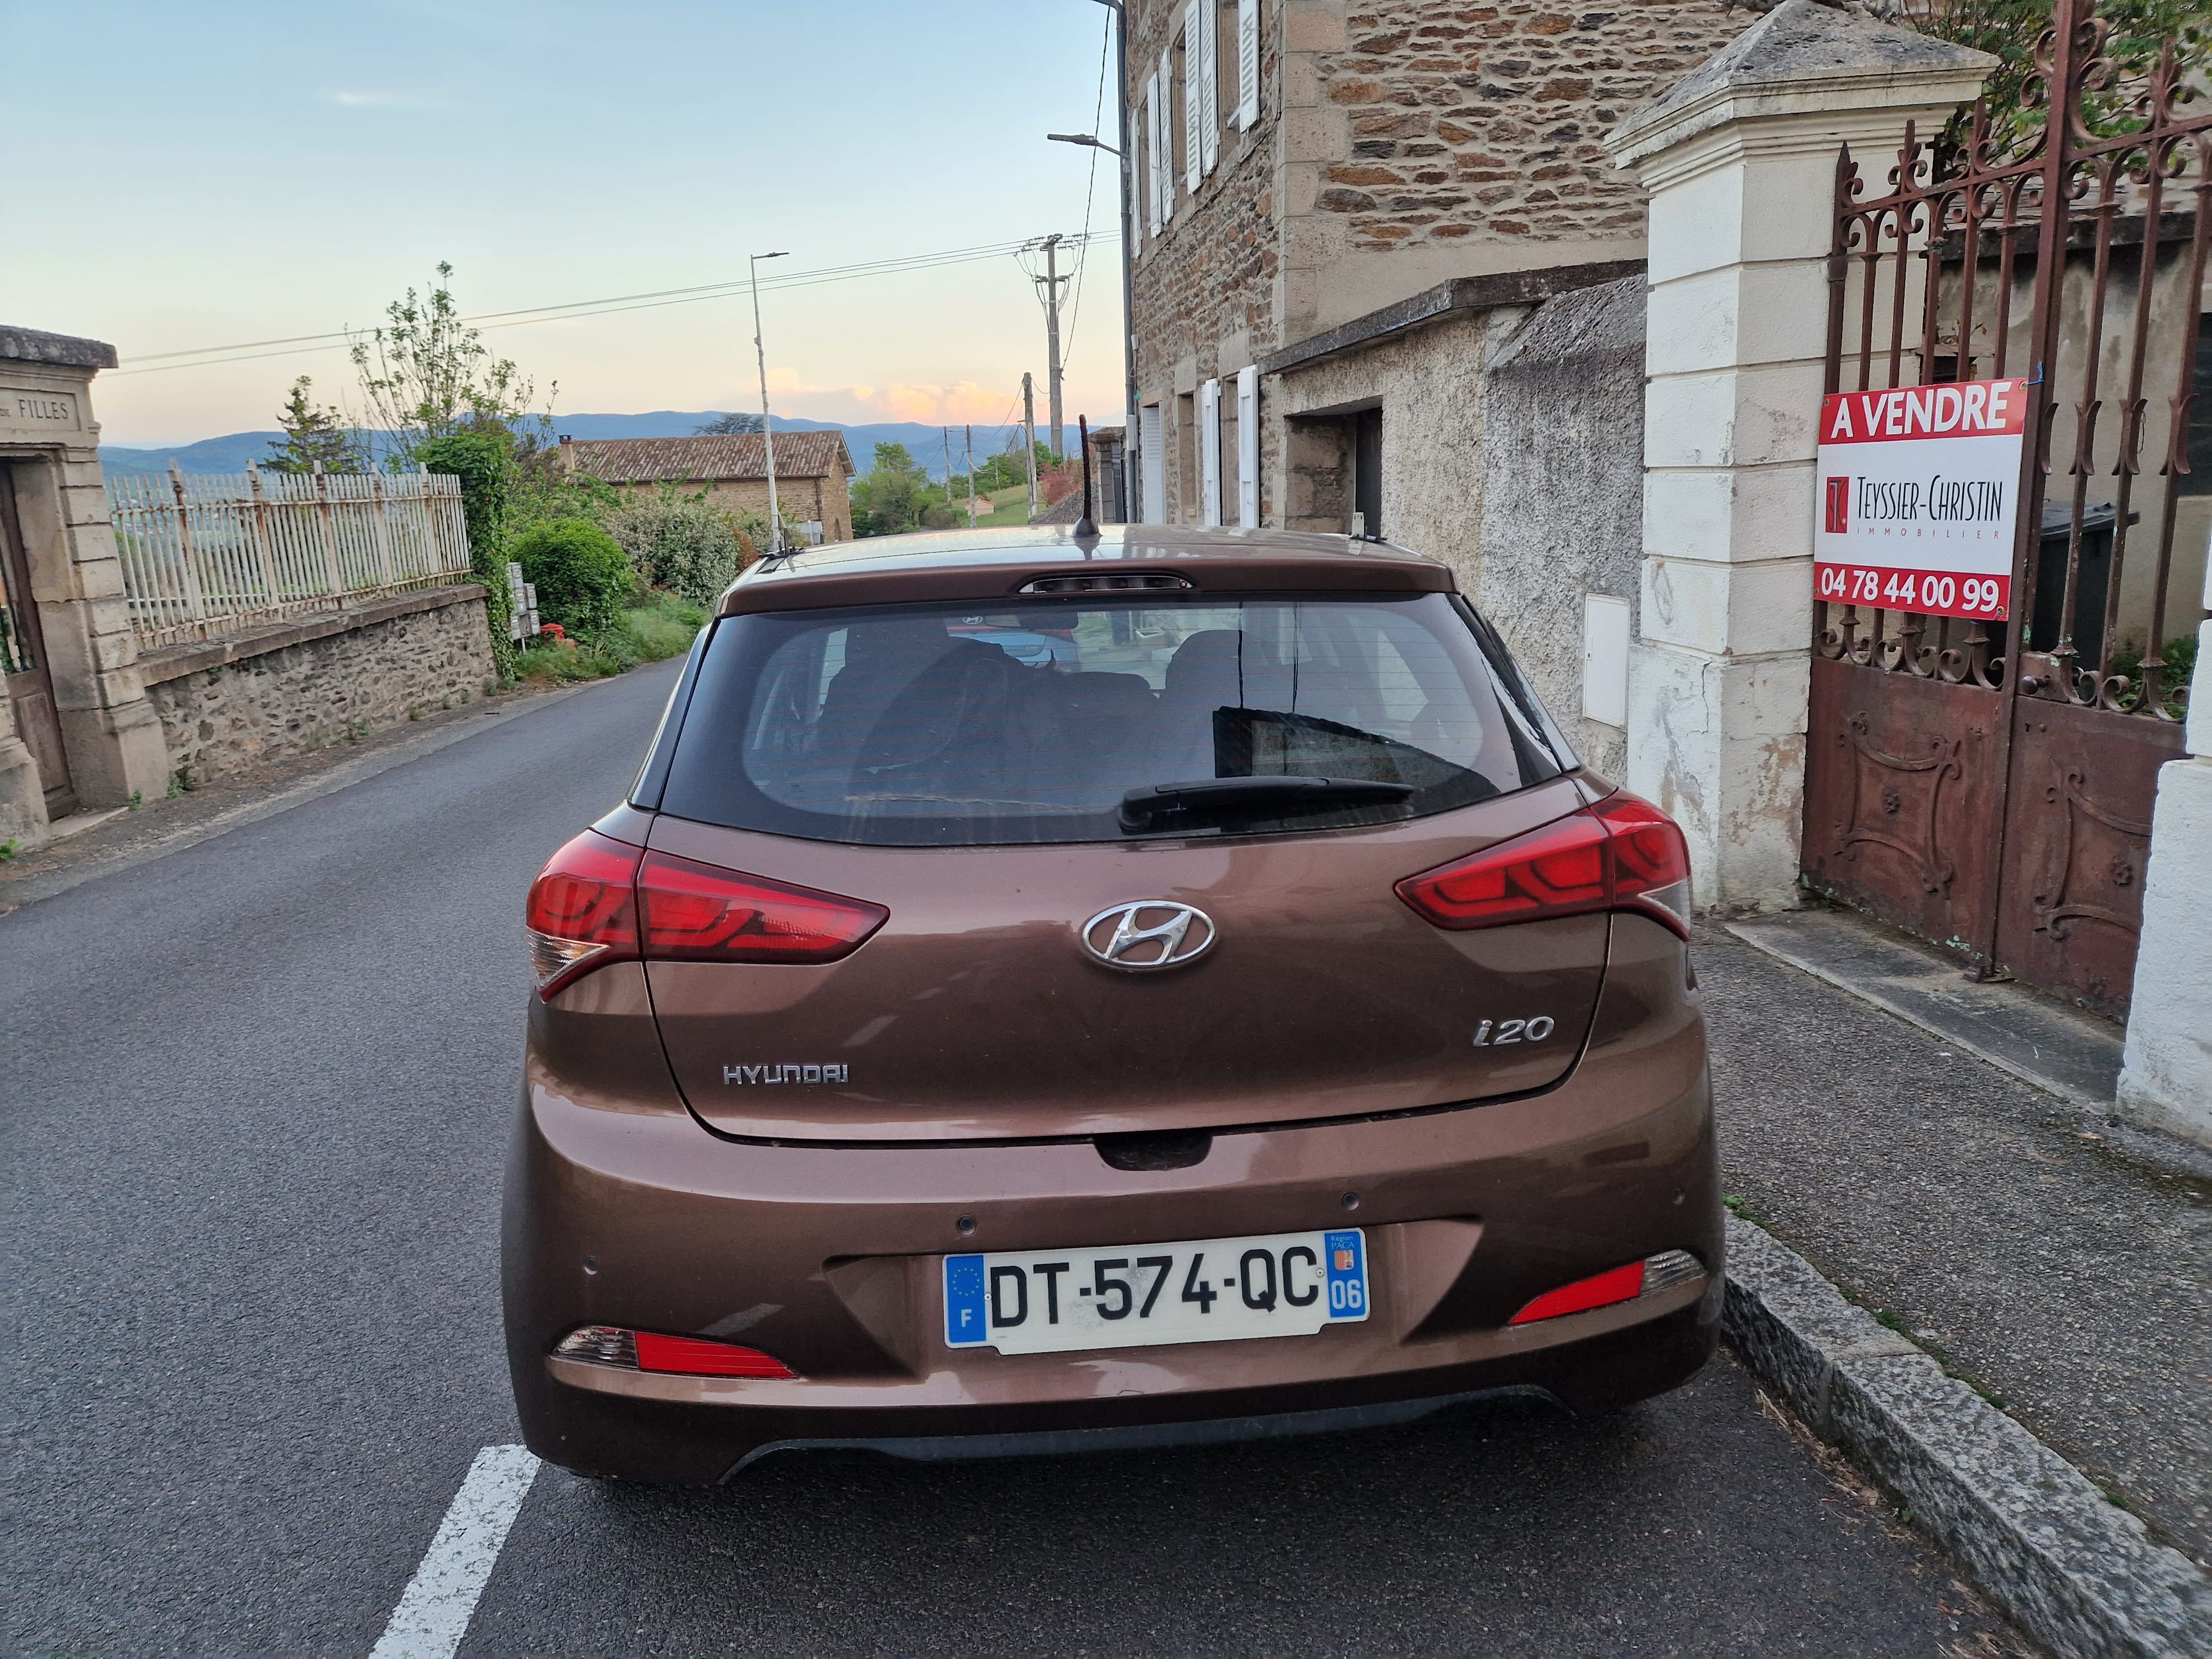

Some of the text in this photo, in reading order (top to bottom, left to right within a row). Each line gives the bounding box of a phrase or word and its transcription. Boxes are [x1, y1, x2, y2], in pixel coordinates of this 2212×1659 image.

[18, 399, 69, 419] FILLES
[1831, 382, 2013, 439] A VENDRE
[1857, 474, 2003, 521] TEYSSIER-CHRISTIN
[1857, 527, 1999, 539] IMMOBILIER
[1821, 567, 2000, 612] 04 78 44 00 99
[1473, 1016, 1554, 1047] i20
[723, 1065, 848, 1085] HYUNDAI
[990, 1246, 1319, 1328] DT-574-QC
[1331, 1279, 1362, 1310] 06
[961, 1308, 972, 1328] F
